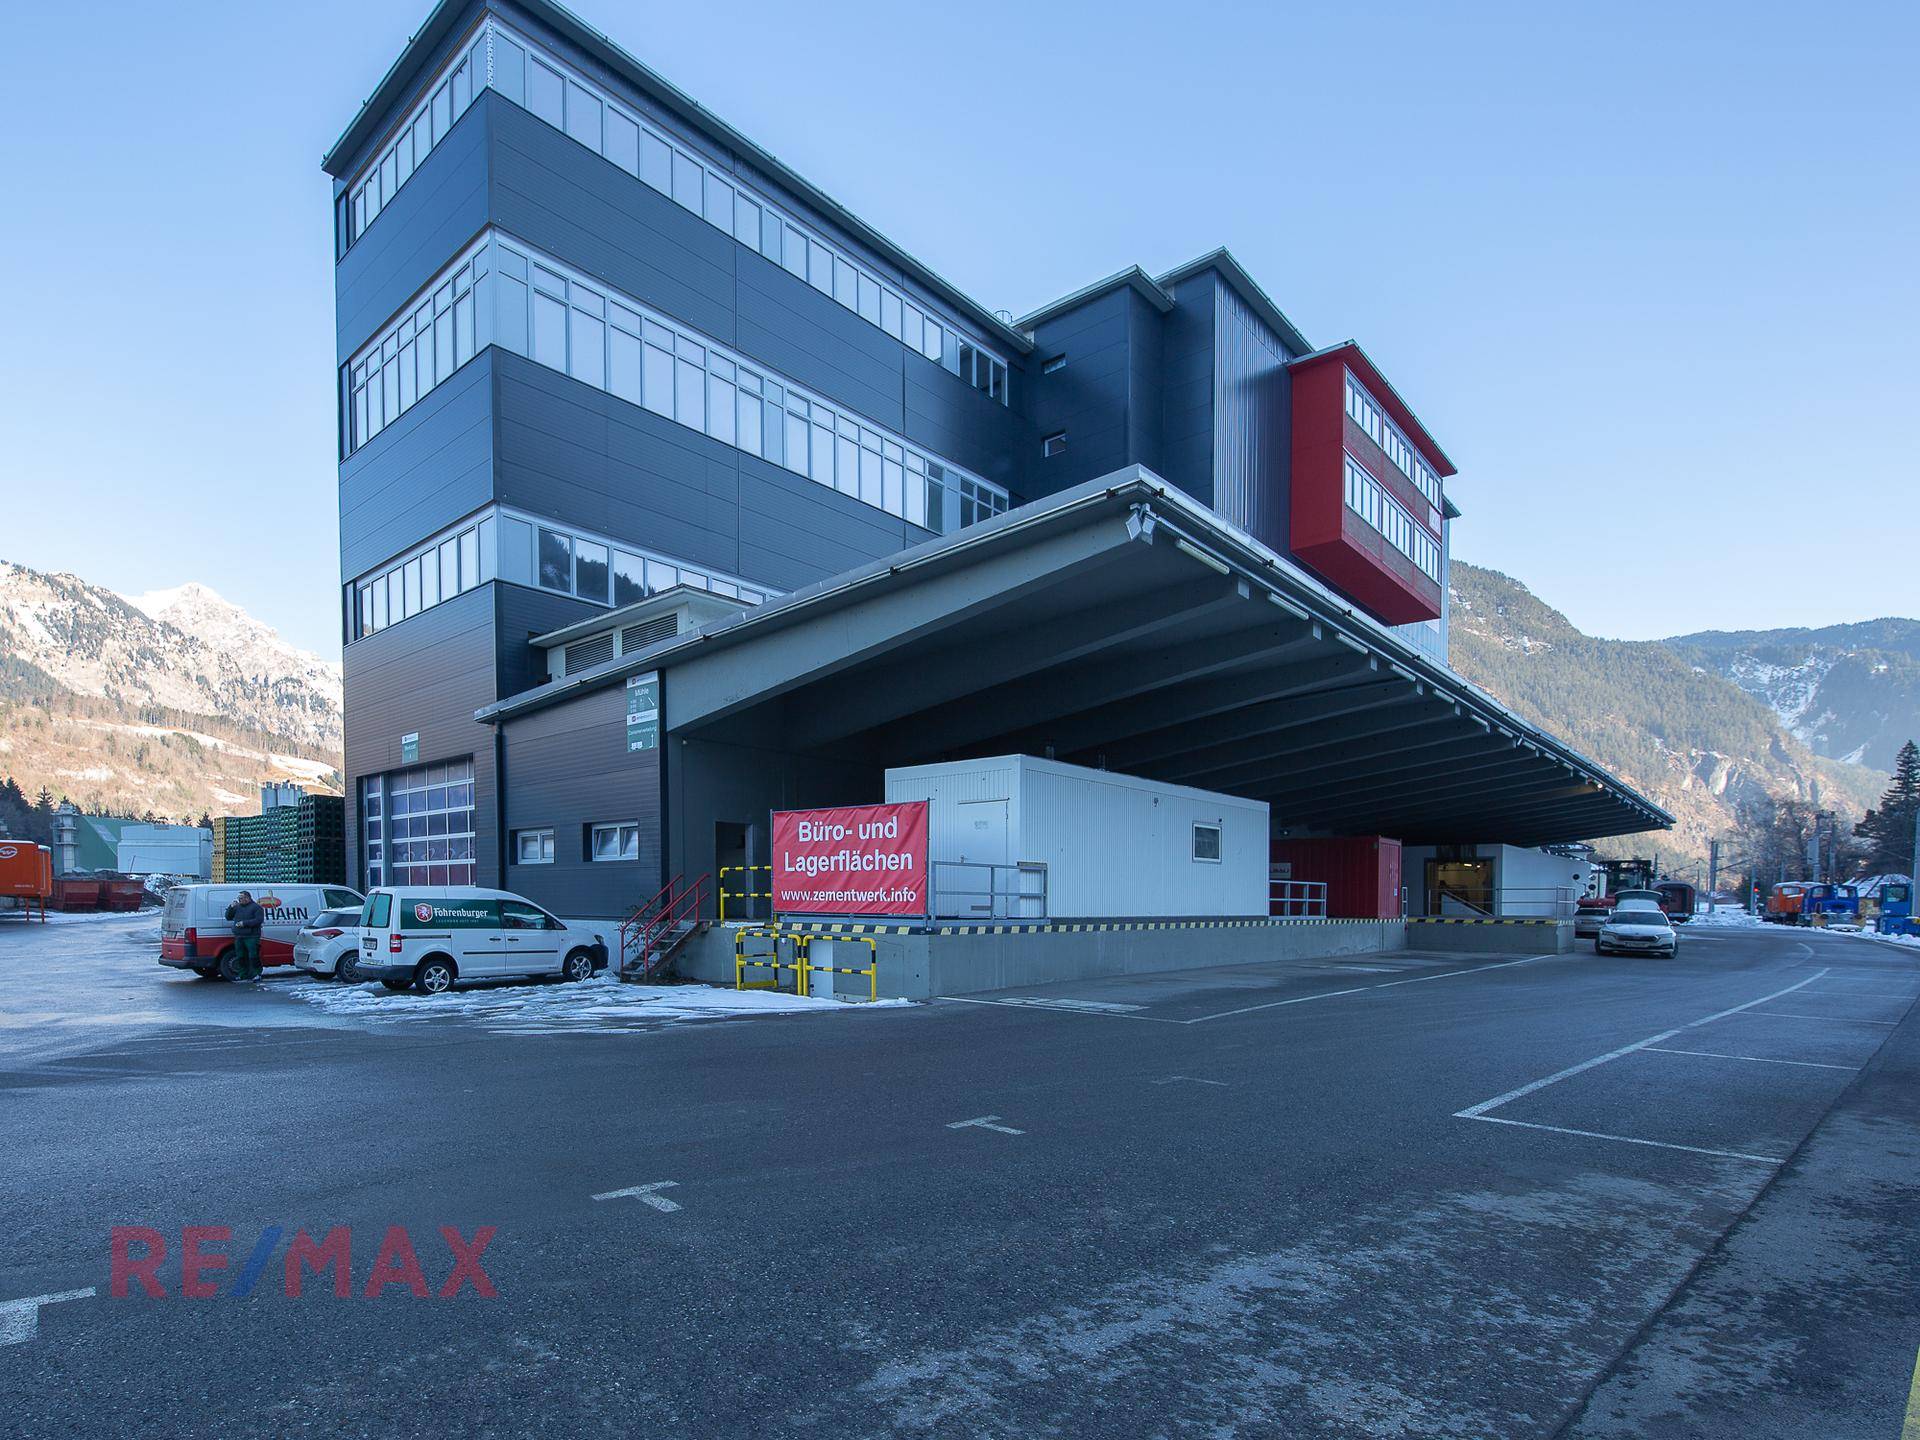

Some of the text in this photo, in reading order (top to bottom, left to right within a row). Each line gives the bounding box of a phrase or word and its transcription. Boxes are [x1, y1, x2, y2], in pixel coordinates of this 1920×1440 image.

[798, 815, 898, 843] Büro- und
[784, 849, 913, 878] Lagerflächen
[781, 886, 917, 903] www.zementwerk.info
[433, 907, 488, 919] Fohrenburger
